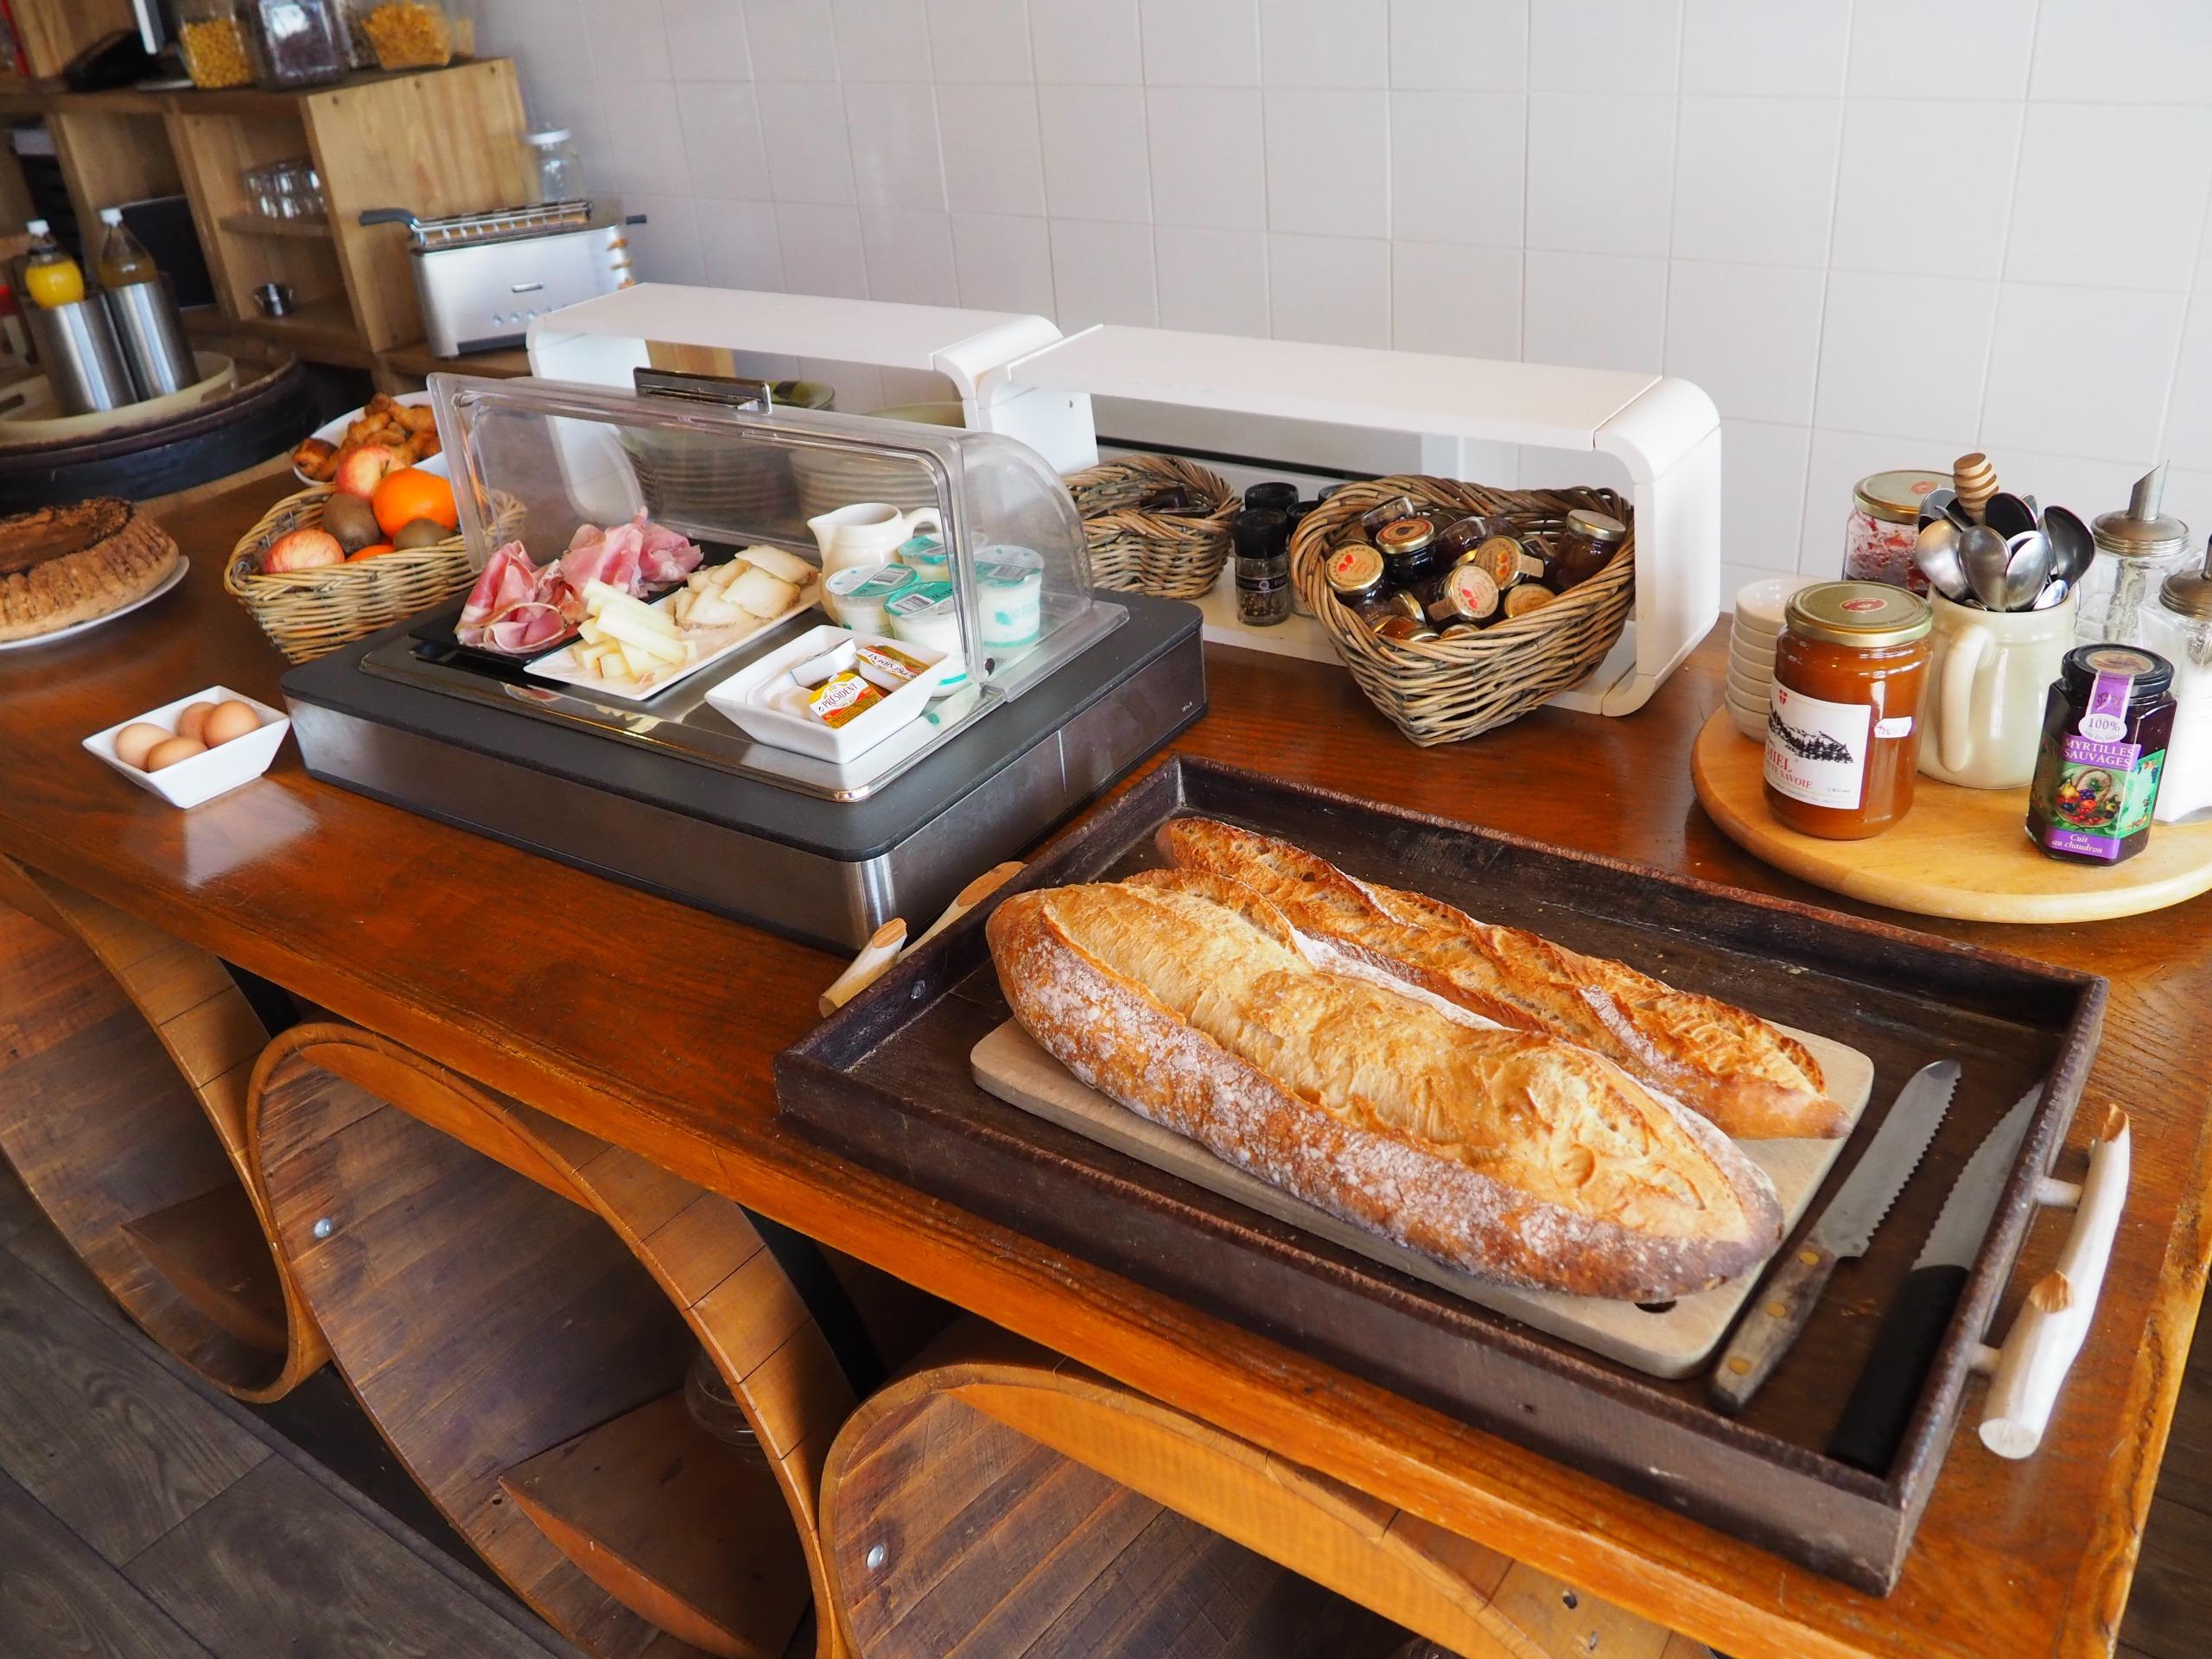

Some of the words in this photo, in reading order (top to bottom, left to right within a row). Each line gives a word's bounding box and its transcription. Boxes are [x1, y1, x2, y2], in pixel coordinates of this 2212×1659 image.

[2088, 717, 2120, 732] 100%
[2066, 738, 2134, 757] MYRTILLES
[1766, 745, 1792, 772] MIEL
[2064, 748, 2131, 766] SAUVAGES
[2069, 834, 2088, 843] Cuit
[2064, 841, 2103, 854] chaudron
